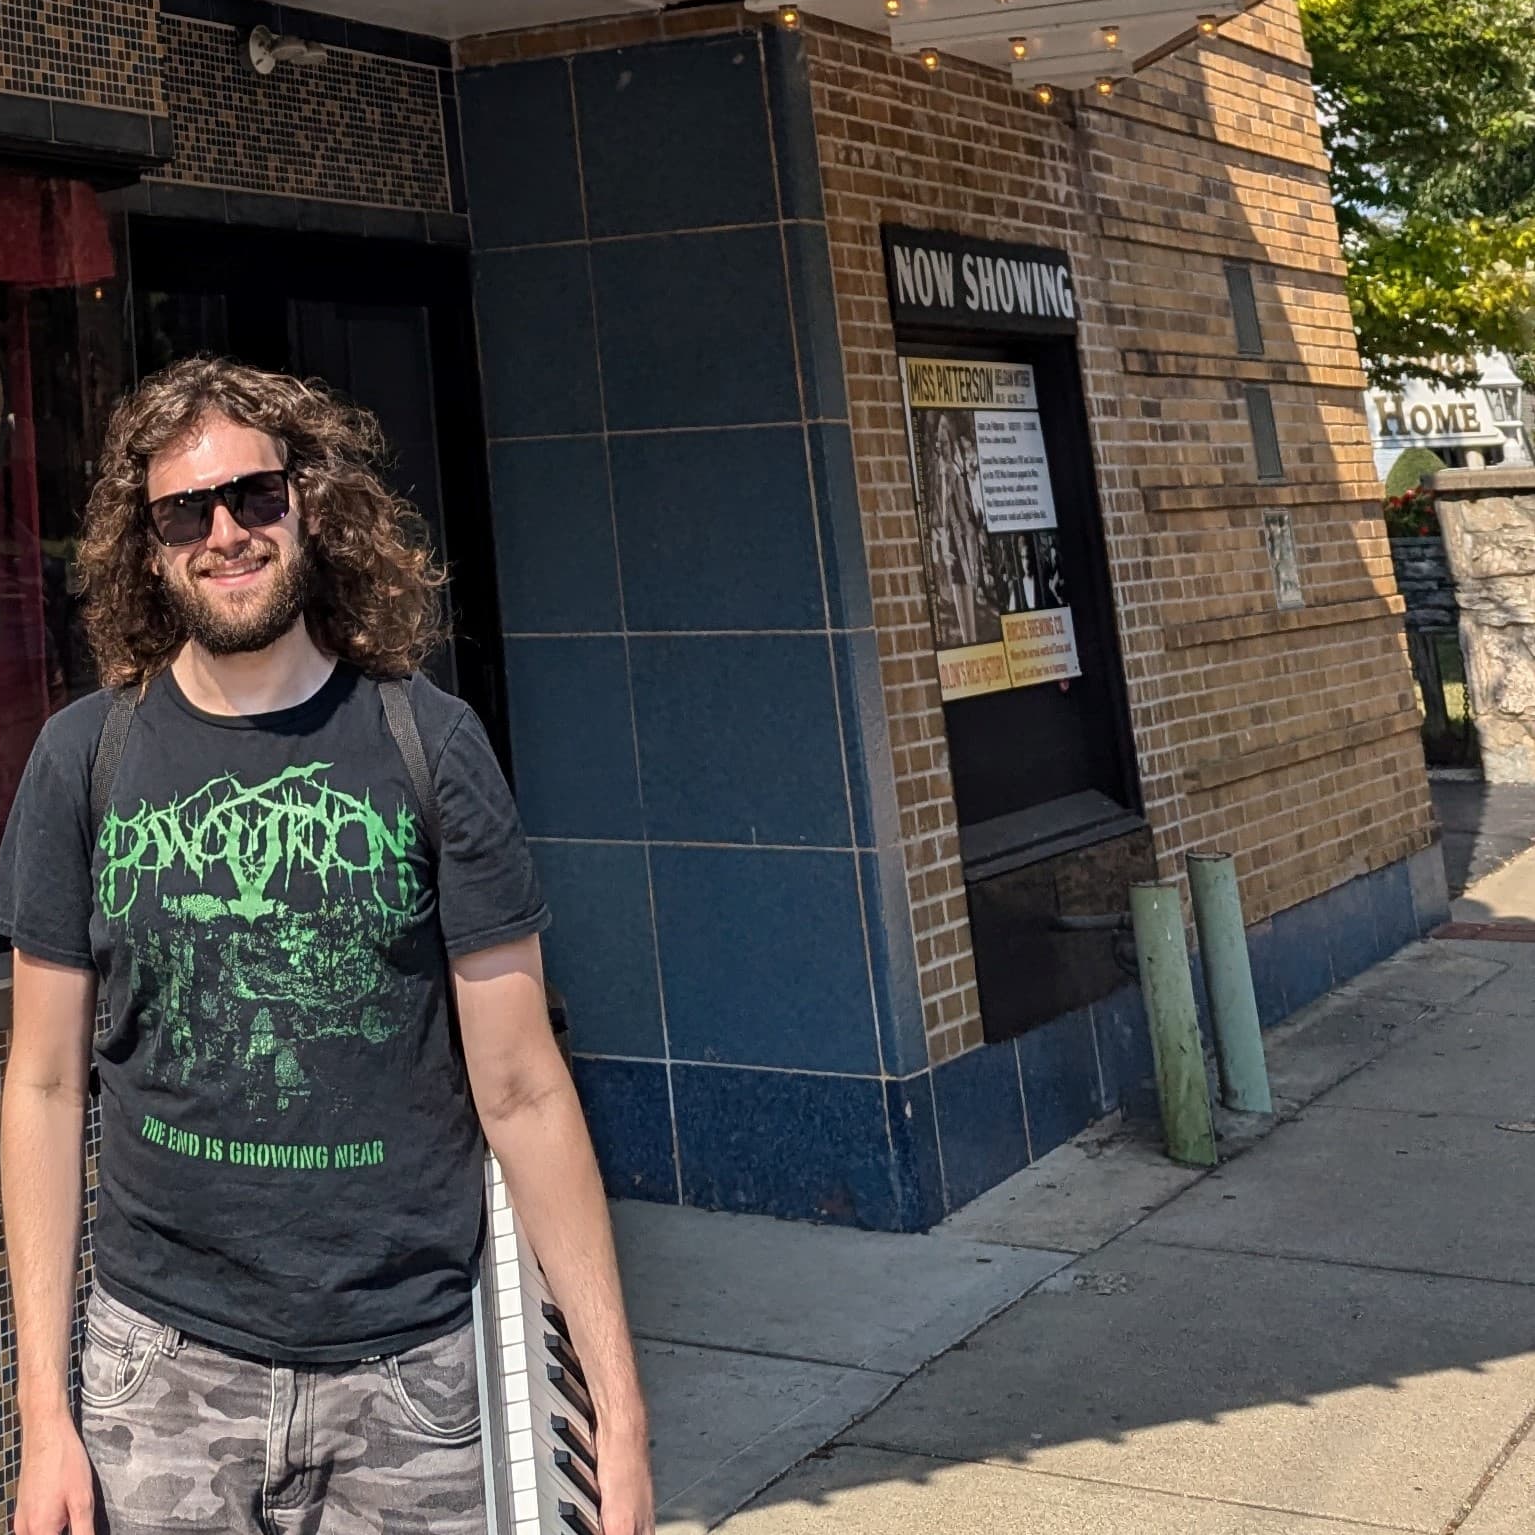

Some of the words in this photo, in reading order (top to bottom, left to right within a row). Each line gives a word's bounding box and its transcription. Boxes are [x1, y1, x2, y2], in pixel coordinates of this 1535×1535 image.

[894, 245, 955, 308] NOW
[962, 253, 1075, 319] SHOWING
[909, 364, 936, 402] MISS
[936, 365, 994, 404] PATTERSON
[1375, 395, 1480, 436] HOME
[142, 1115, 166, 1146] THE
[168, 1126, 200, 1157] END
[206, 1136, 224, 1162] IS
[229, 1141, 329, 1169] GROWING
[334, 1139, 385, 1169] NEAR
